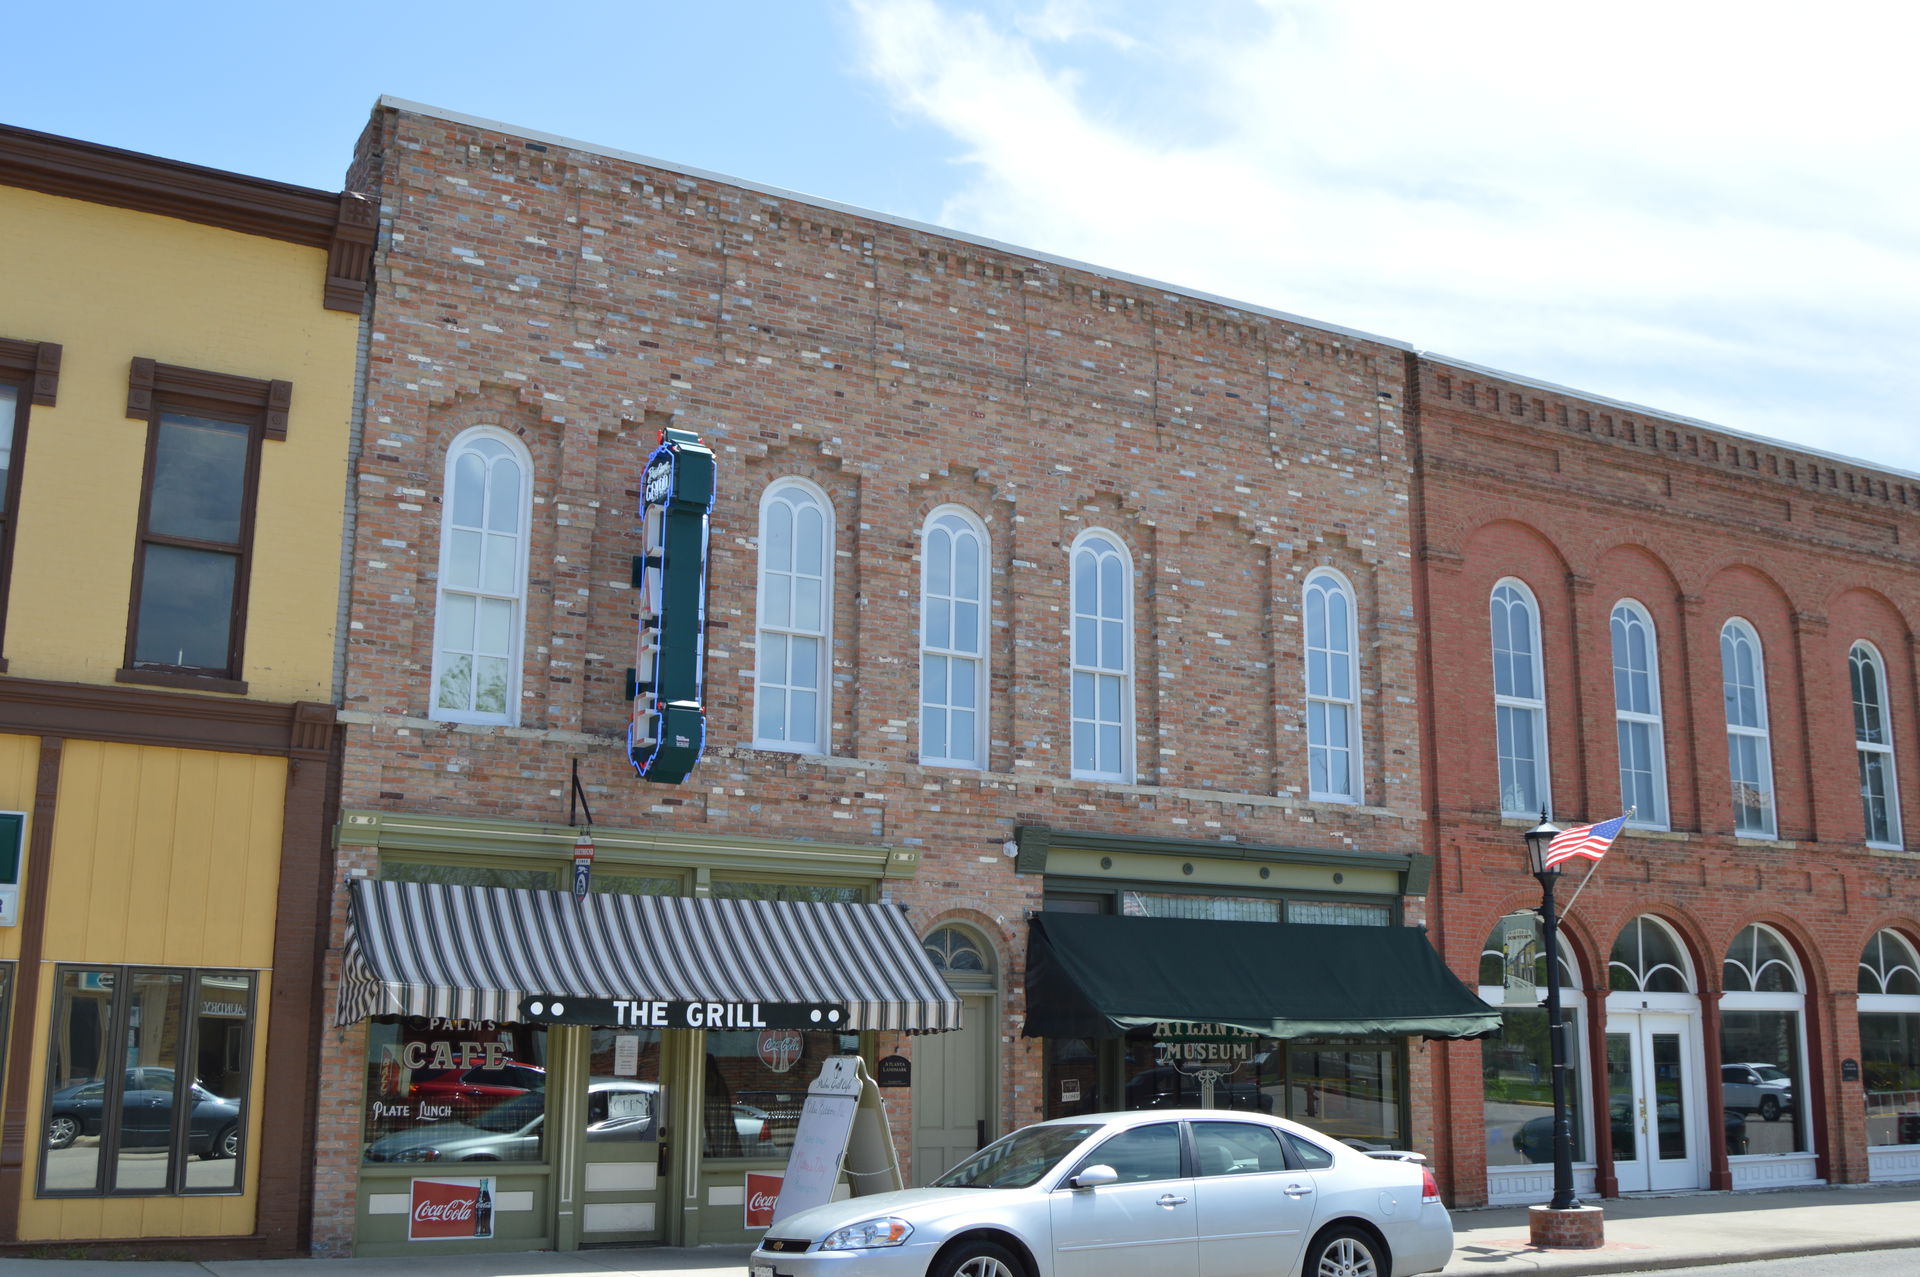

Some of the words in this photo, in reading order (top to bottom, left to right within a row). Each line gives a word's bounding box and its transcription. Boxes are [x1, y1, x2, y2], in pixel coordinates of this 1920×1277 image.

[429, 1018, 496, 1031] PALMS
[613, 1001, 669, 1026] THE
[686, 1002, 767, 1028] GRILL
[402, 1041, 507, 1070] CAFE
[1166, 1043, 1248, 1060] MUSEUM
[414, 1199, 475, 1222] Coca-Cola
